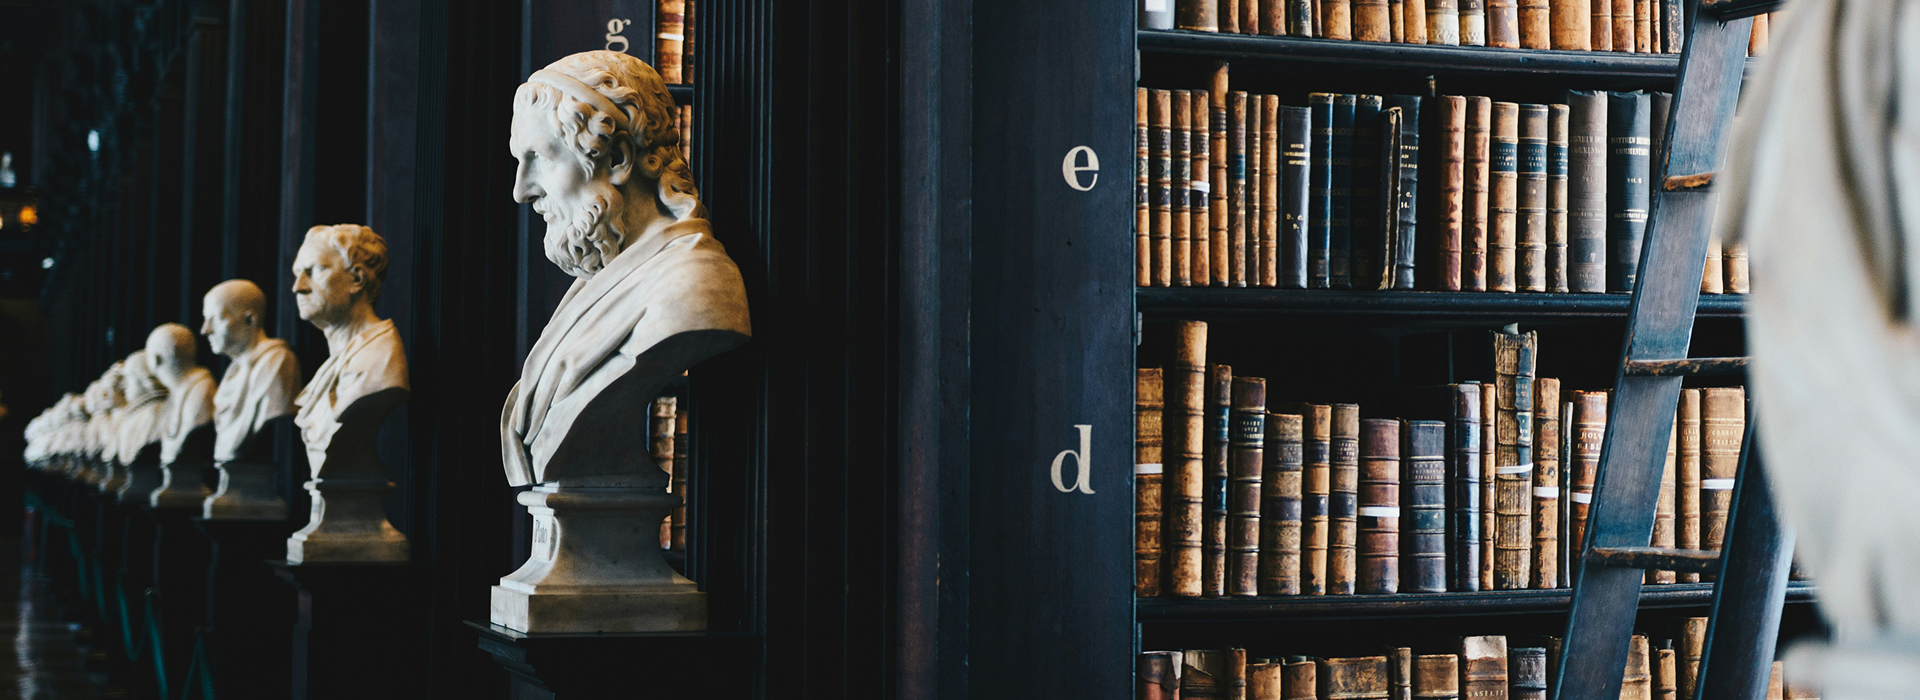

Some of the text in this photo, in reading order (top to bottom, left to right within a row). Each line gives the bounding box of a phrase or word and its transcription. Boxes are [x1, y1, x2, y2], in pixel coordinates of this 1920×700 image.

[605, 18, 632, 53] g
[1062, 145, 1100, 192] e
[1576, 442, 1601, 451] BIBL
[1581, 431, 1603, 440] HOLY
[1050, 424, 1096, 495] d
[535, 519, 548, 544] Plato
